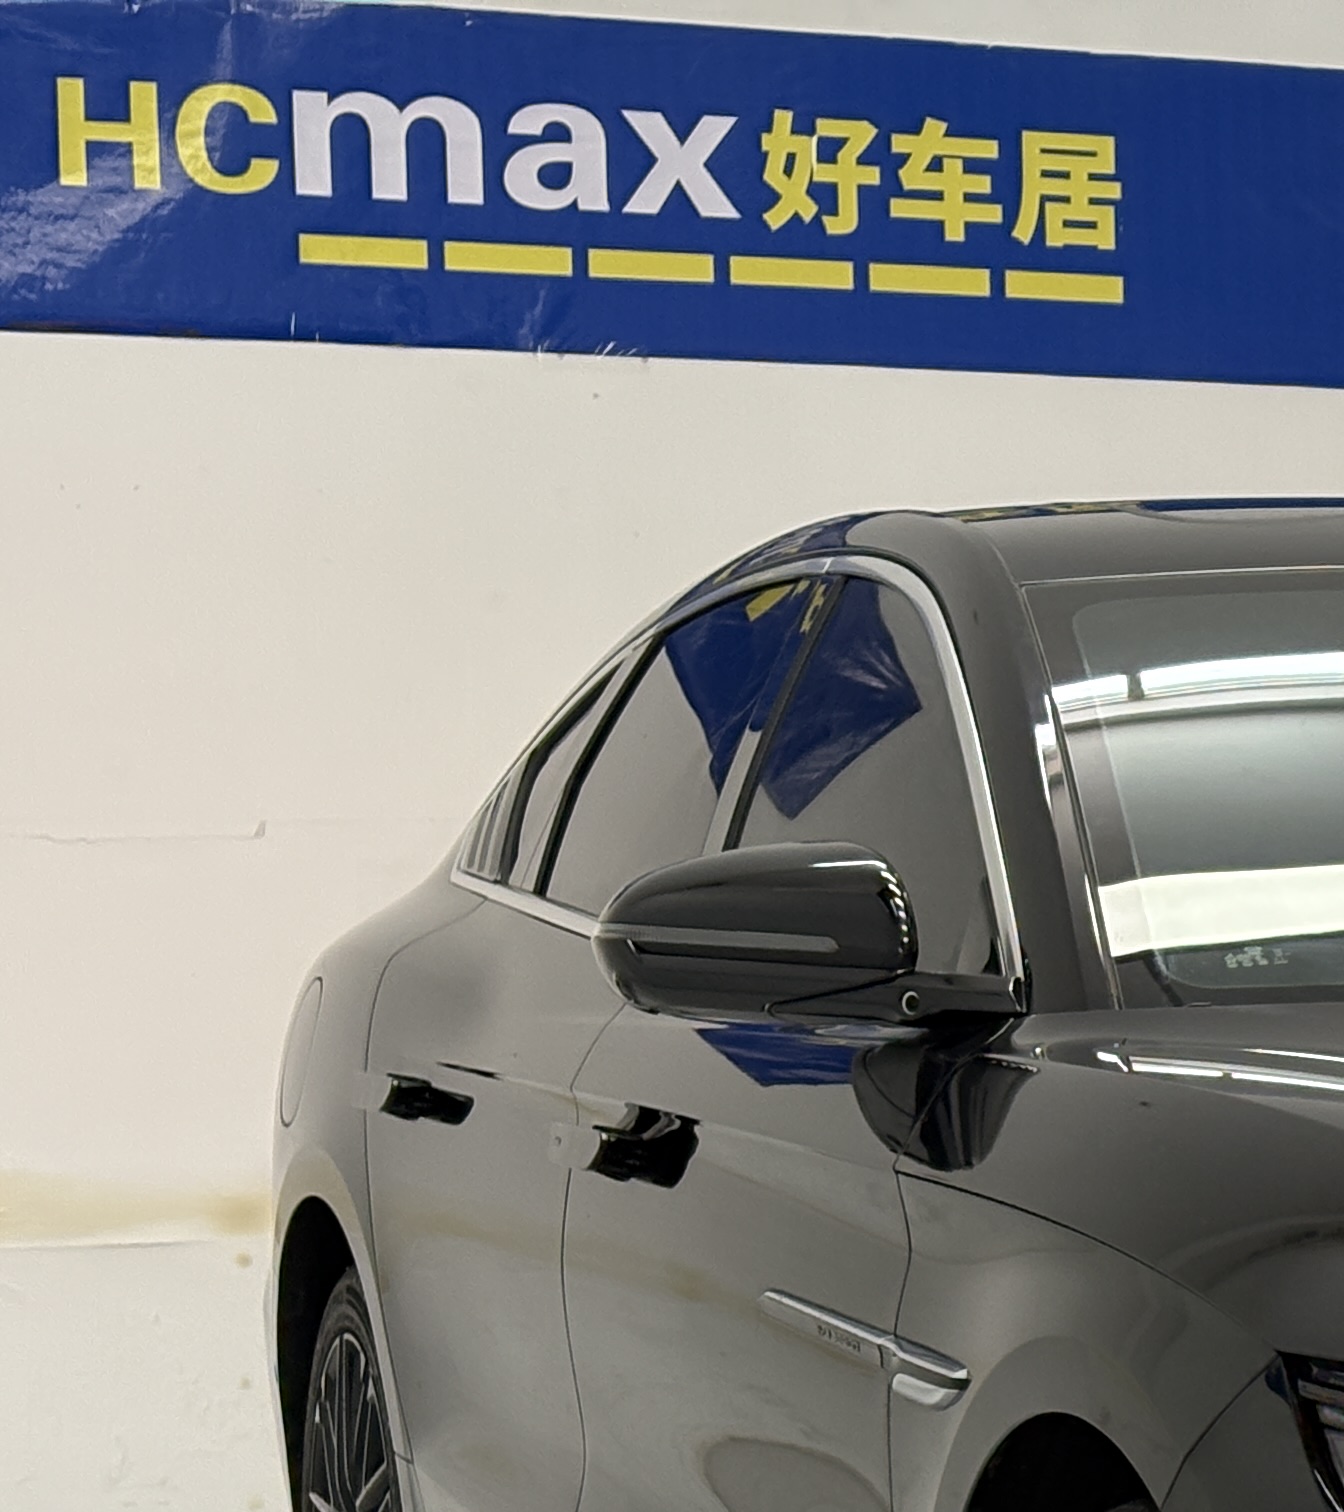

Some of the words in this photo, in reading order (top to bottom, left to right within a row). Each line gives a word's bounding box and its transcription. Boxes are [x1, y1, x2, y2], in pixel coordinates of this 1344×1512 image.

[56, 77, 742, 219] HCmax
[761, 110, 1122, 250] 好车居
